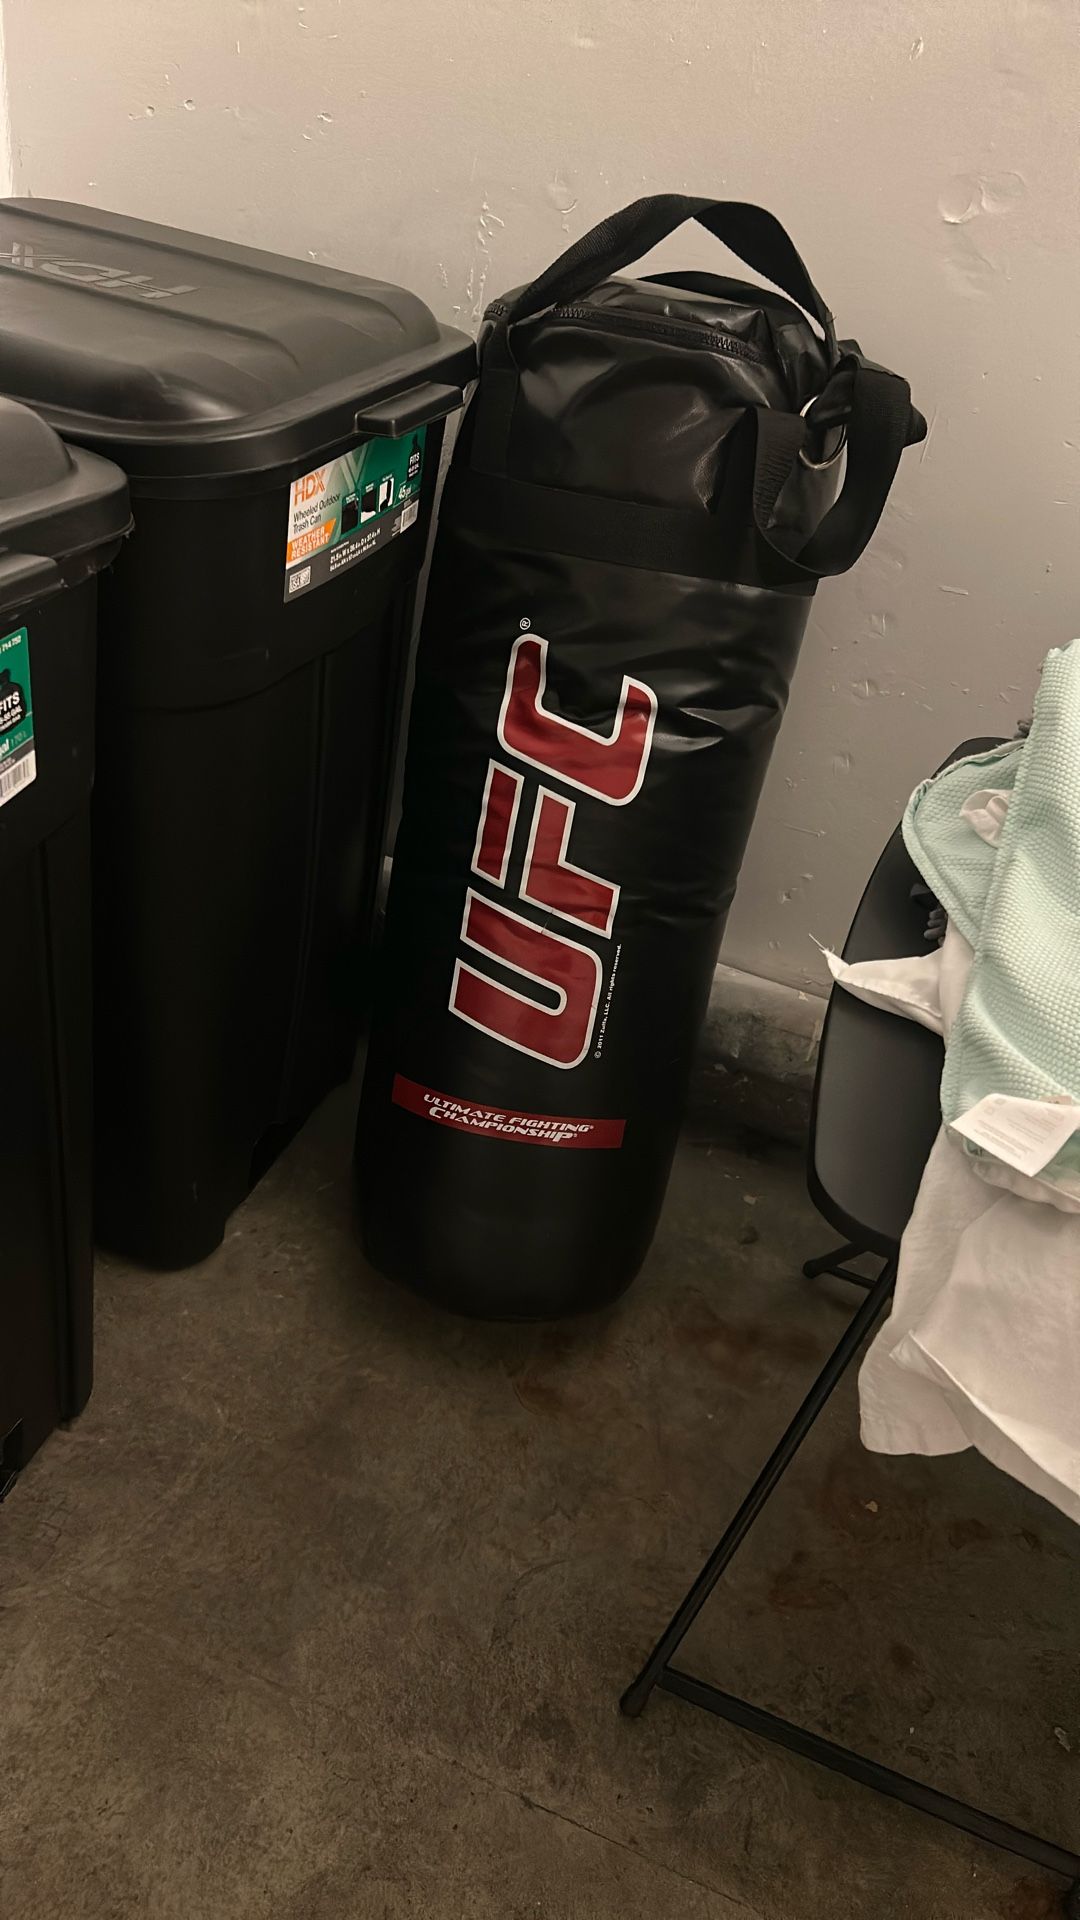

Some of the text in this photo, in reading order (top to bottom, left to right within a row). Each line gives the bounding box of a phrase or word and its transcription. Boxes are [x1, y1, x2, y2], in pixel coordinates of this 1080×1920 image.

[294, 468, 326, 506] HDX
[293, 502, 319, 523] Wheeled
[319, 493, 340, 511] Outdoor
[291, 526, 325, 549] WEATHER
[293, 514, 321, 534] Trash Can
[291, 532, 330, 560] RESISTANT
[448, 633, 658, 1070] UFC
[423, 1094, 506, 1122] ULTIMATE
